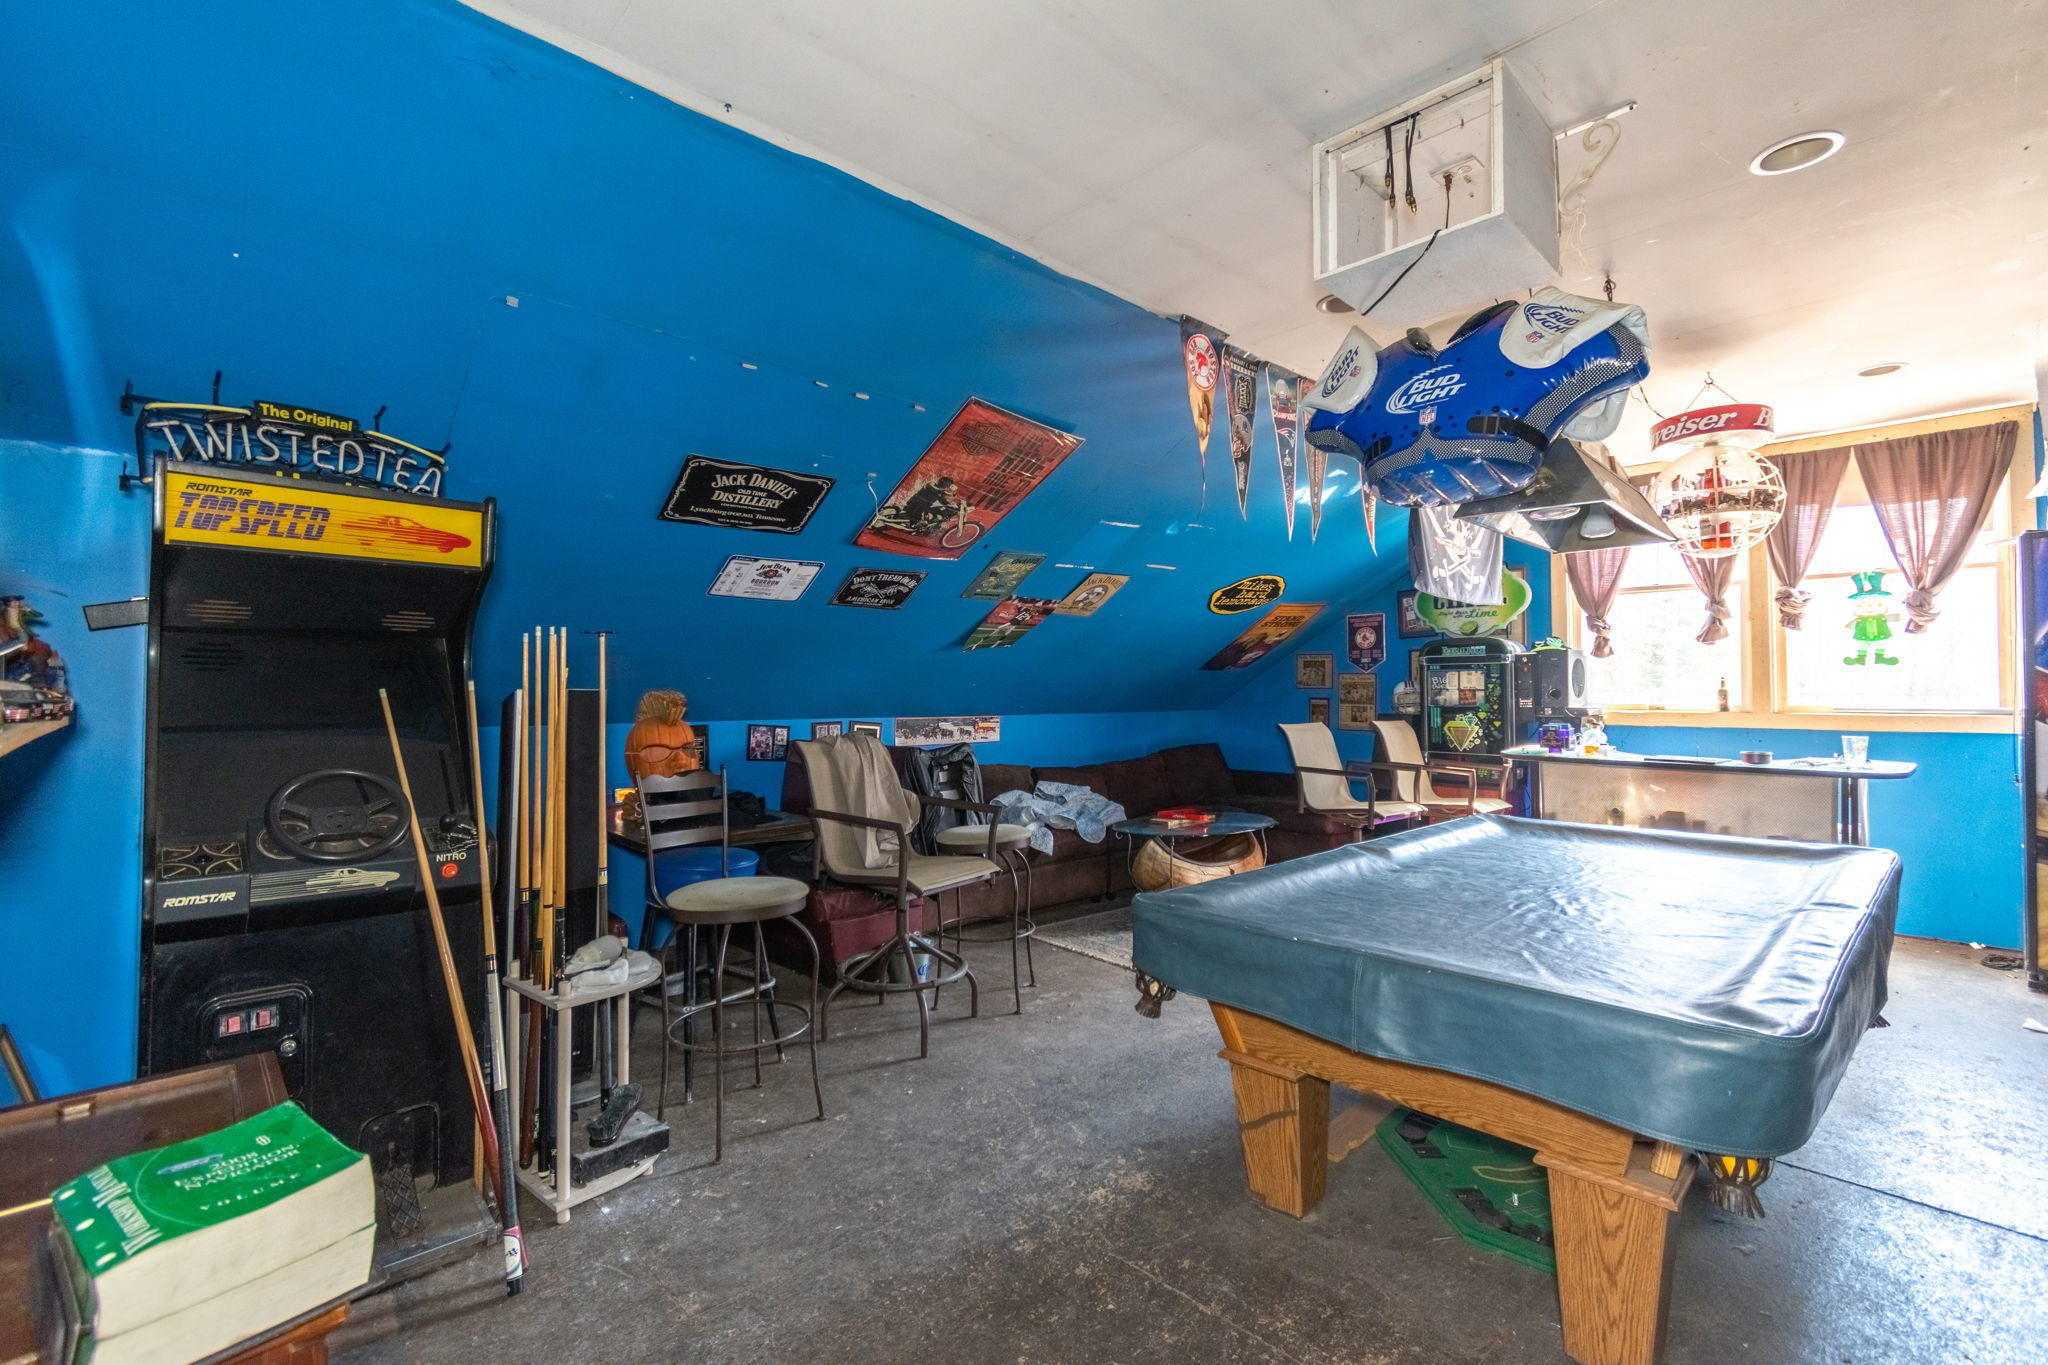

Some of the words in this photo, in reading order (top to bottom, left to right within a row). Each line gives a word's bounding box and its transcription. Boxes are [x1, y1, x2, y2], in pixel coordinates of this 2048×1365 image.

[1529, 312, 1574, 333] LIGHT
[1545, 311, 1580, 325] BUD
[1408, 373, 1461, 395] BUD
[1395, 383, 1467, 410] LIGHT
[259, 403, 290, 420] The
[293, 409, 353, 431] Original
[146, 420, 365, 475] TWISTED
[368, 443, 441, 498] TEA
[185, 482, 253, 496] ROMSTAR
[711, 473, 748, 488] JACK
[748, 473, 798, 499] DANIEL'S
[981, 471, 1014, 488] RIDE
[711, 490, 783, 509] DISTILLERY
[175, 491, 238, 531] TOP
[230, 499, 331, 541] SPEED
[773, 563, 791, 573] BEAM
[1465, 608, 1499, 618] Lime
[436, 852, 467, 862] NITRO
[163, 891, 236, 909] ROMSTAR
